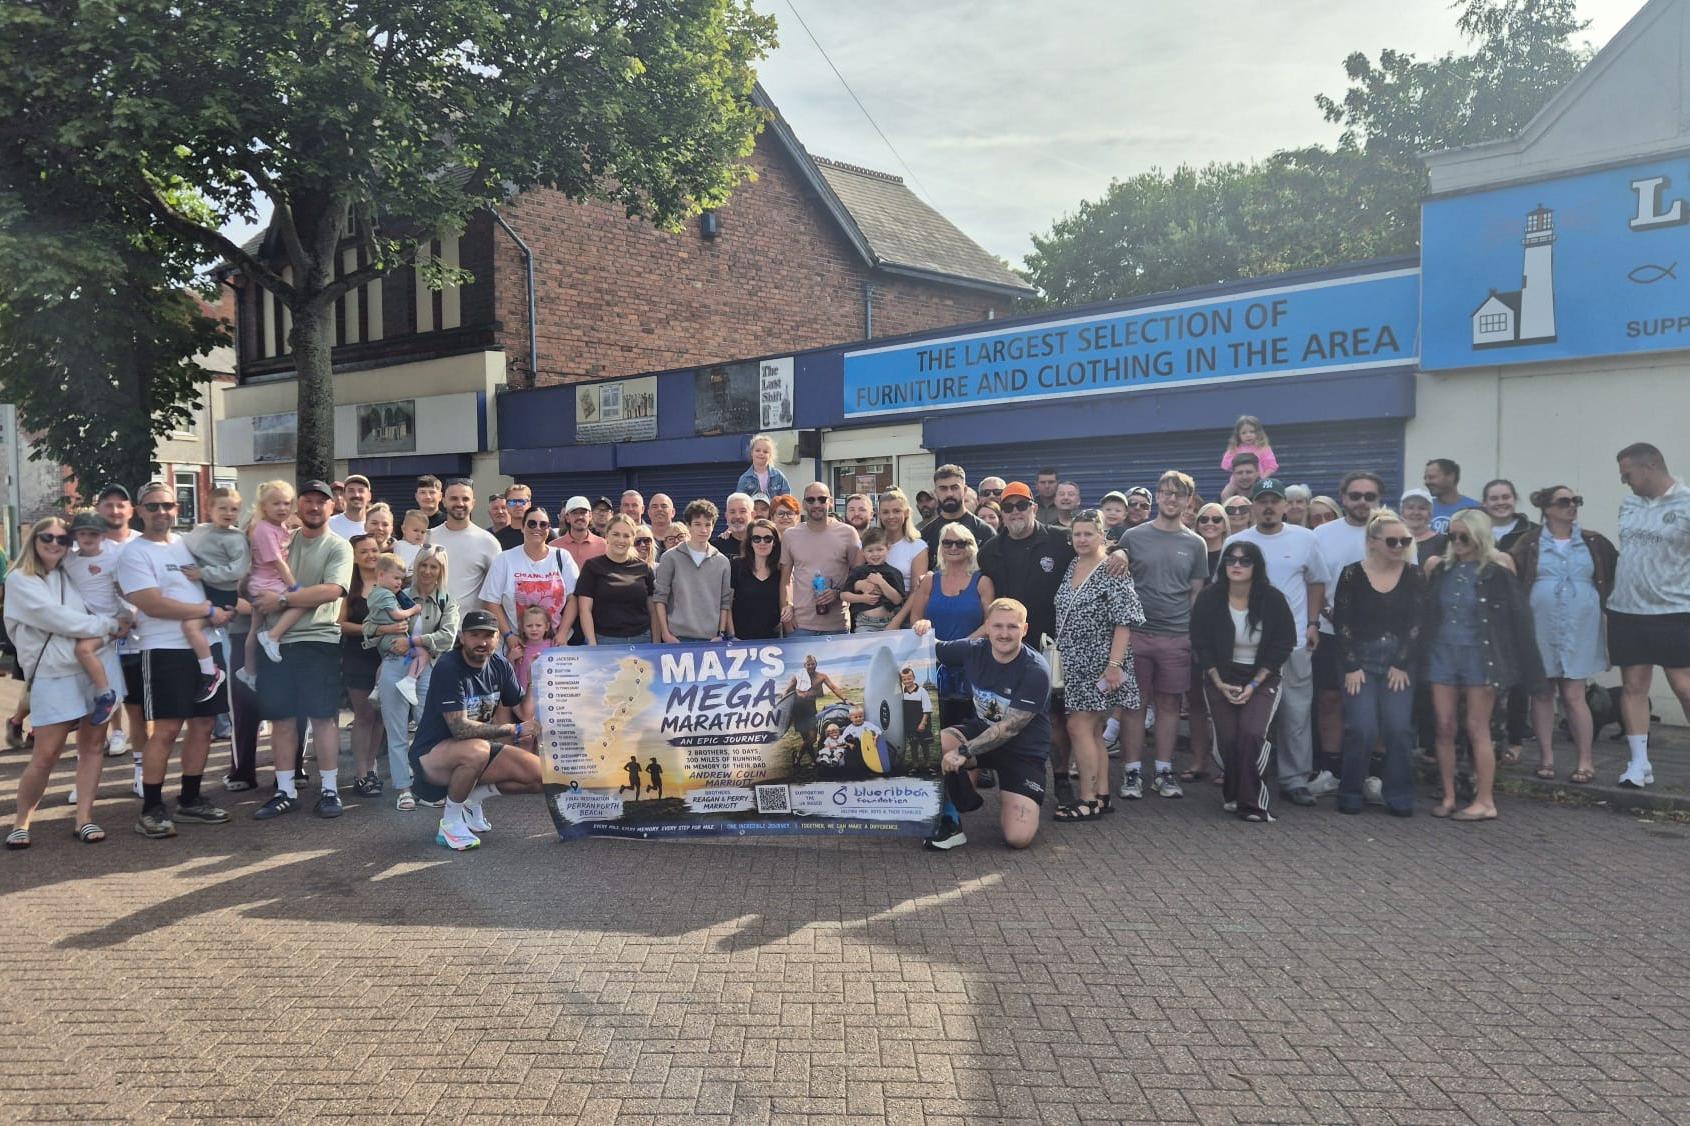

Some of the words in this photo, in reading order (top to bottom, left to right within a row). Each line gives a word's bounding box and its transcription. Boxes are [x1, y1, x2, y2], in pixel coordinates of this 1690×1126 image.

[916, 348, 956, 373] THE
[965, 331, 1069, 367] LARGEST
[1078, 308, 1232, 352] SELECTION
[1245, 300, 1288, 330] OF
[762, 365, 779, 378] The
[856, 375, 968, 408] FURNITURE
[977, 368, 1028, 395] AND
[1038, 352, 1173, 388] CLOTHING
[1186, 346, 1216, 374] IN
[1228, 337, 1288, 368] THE
[1301, 325, 1400, 362] AREA
[761, 378, 781, 391] Last
[762, 391, 782, 403] Shift
[661, 645, 785, 684] MAZ'S
[666, 679, 777, 714] MEGA
[661, 709, 780, 734] MARATHON
[697, 737, 718, 745] EPIC
[724, 734, 768, 744] JOURNEY
[689, 771, 732, 779] ANDREW
[736, 770, 768, 778] COLIN
[705, 779, 753, 788] MARRIOTT
[579, 809, 603, 817] BEACH
